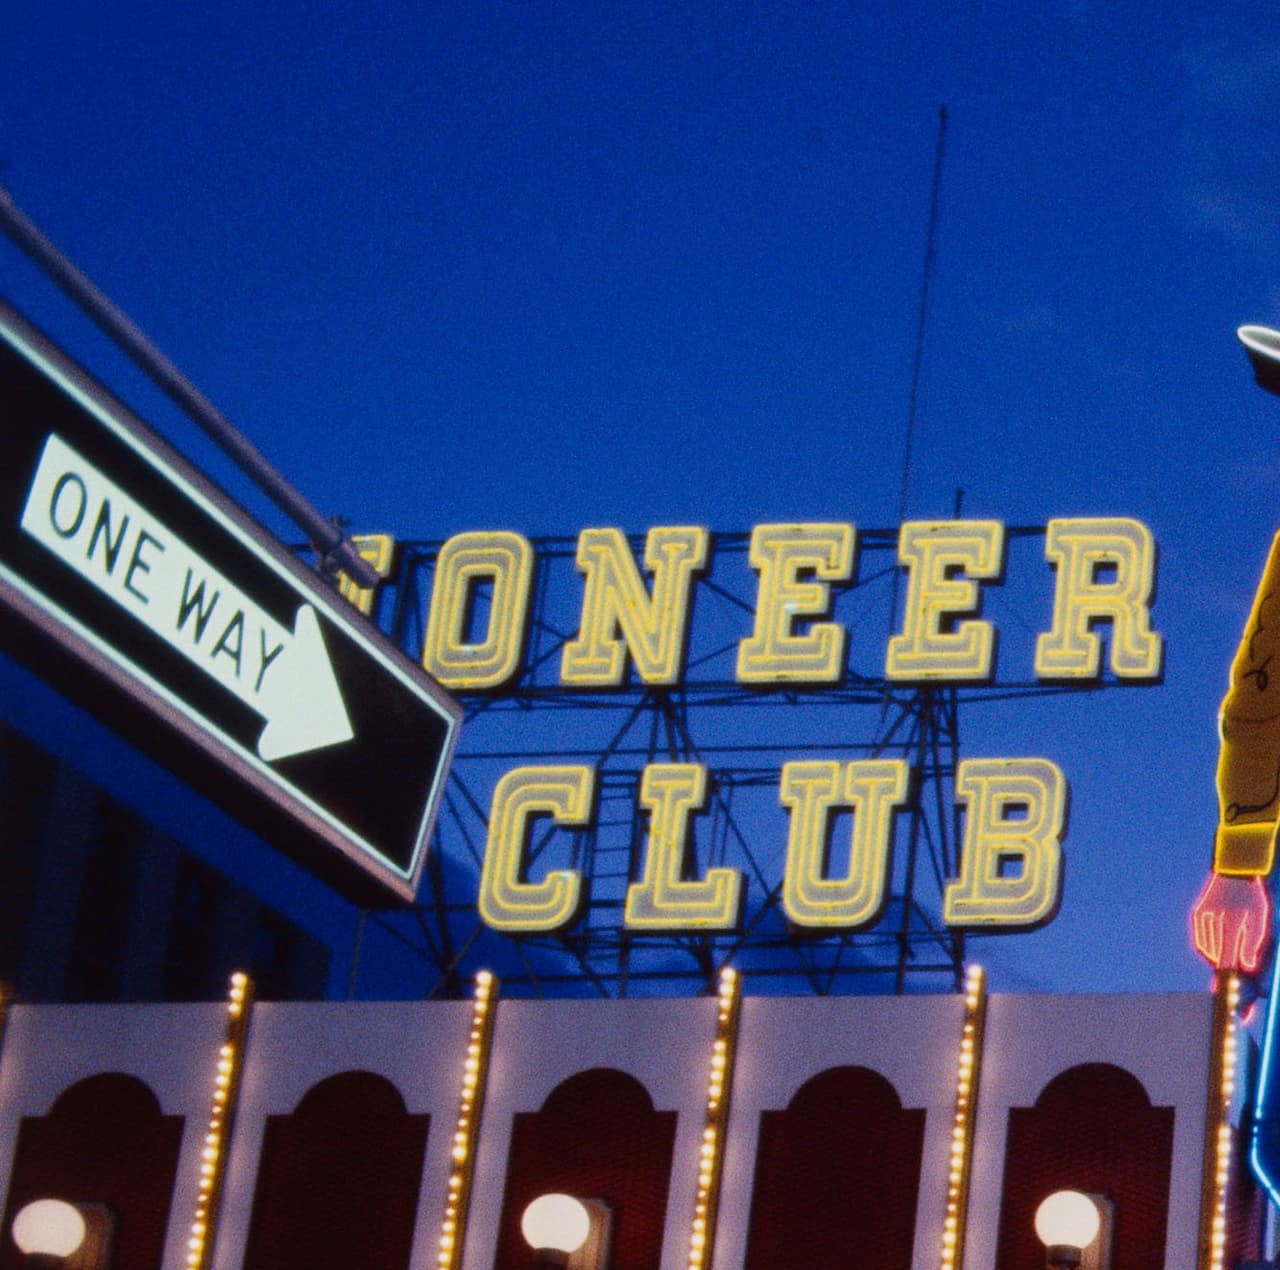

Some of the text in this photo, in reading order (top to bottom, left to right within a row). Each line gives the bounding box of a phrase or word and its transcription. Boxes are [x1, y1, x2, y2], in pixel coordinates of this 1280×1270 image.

[49, 471, 285, 693] ONE WAY
[477, 757, 1067, 932] CLUB
